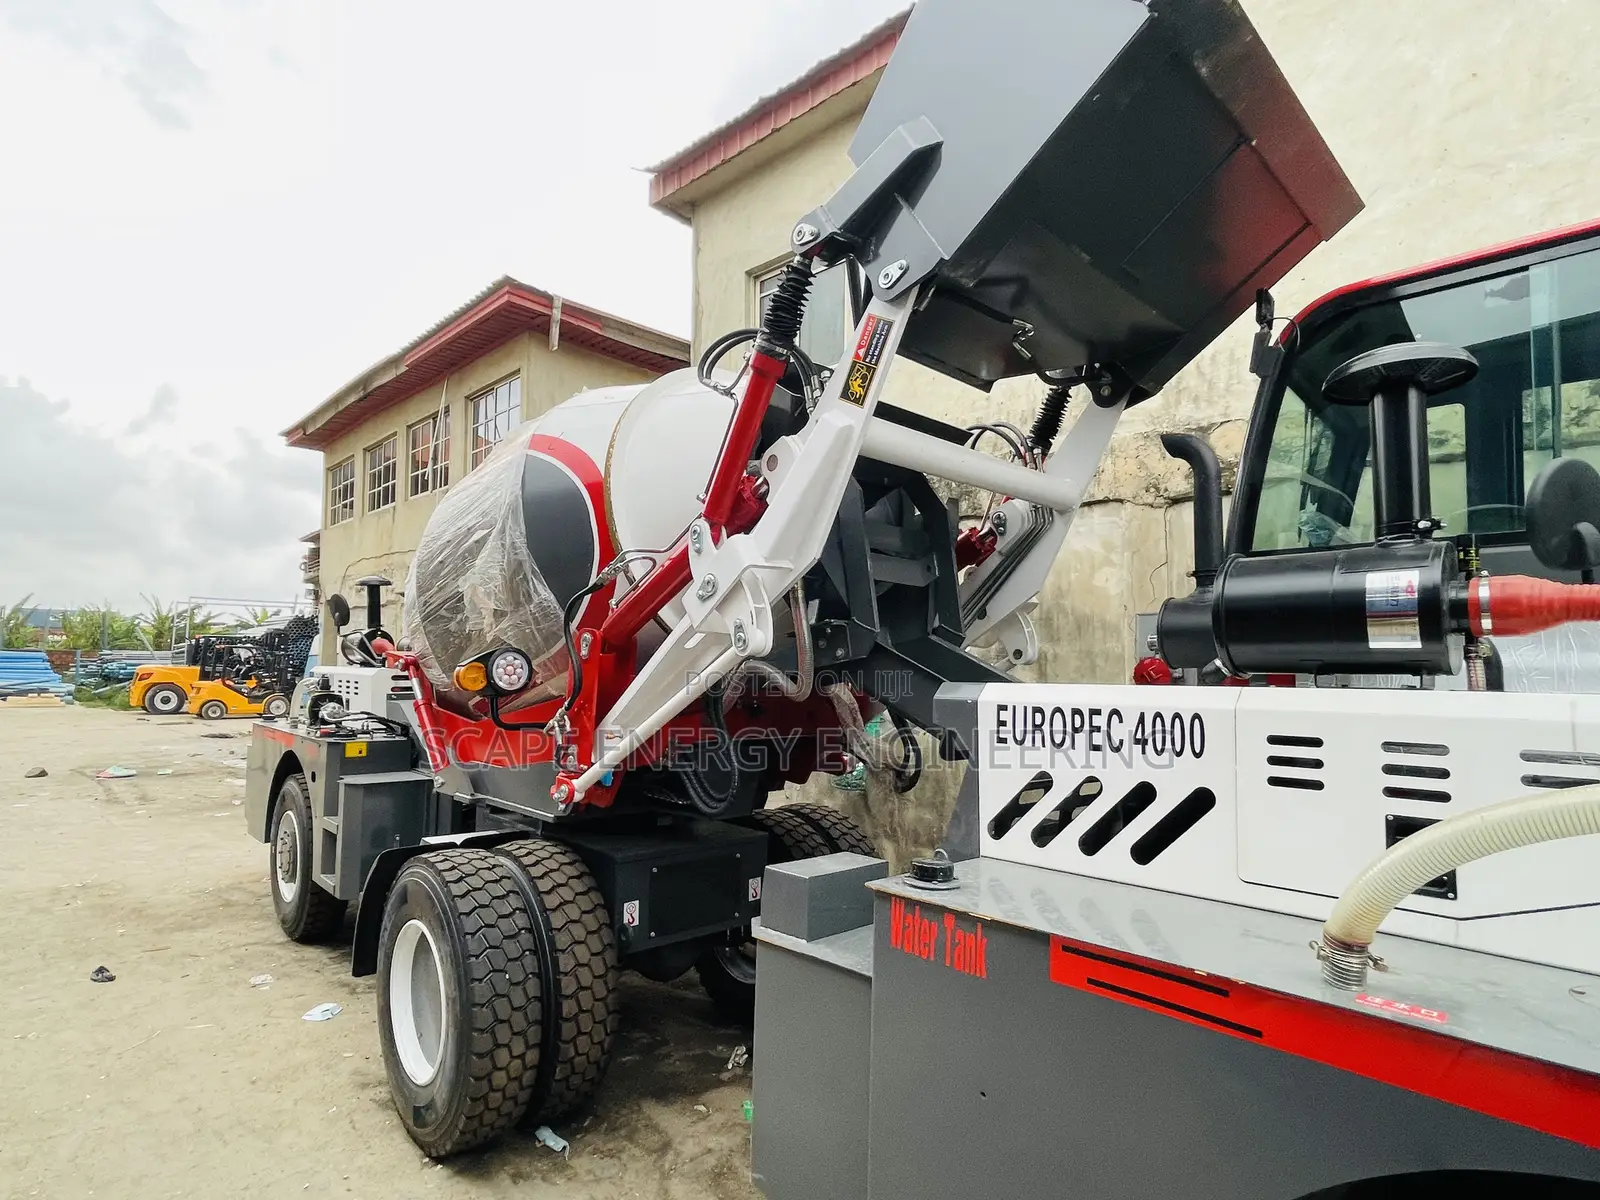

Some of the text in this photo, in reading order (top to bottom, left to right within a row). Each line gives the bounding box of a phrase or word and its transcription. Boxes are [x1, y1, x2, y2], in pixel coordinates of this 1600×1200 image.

[995, 703, 1206, 759] EUROPEC 4000
[890, 896, 989, 979] Water Tank
